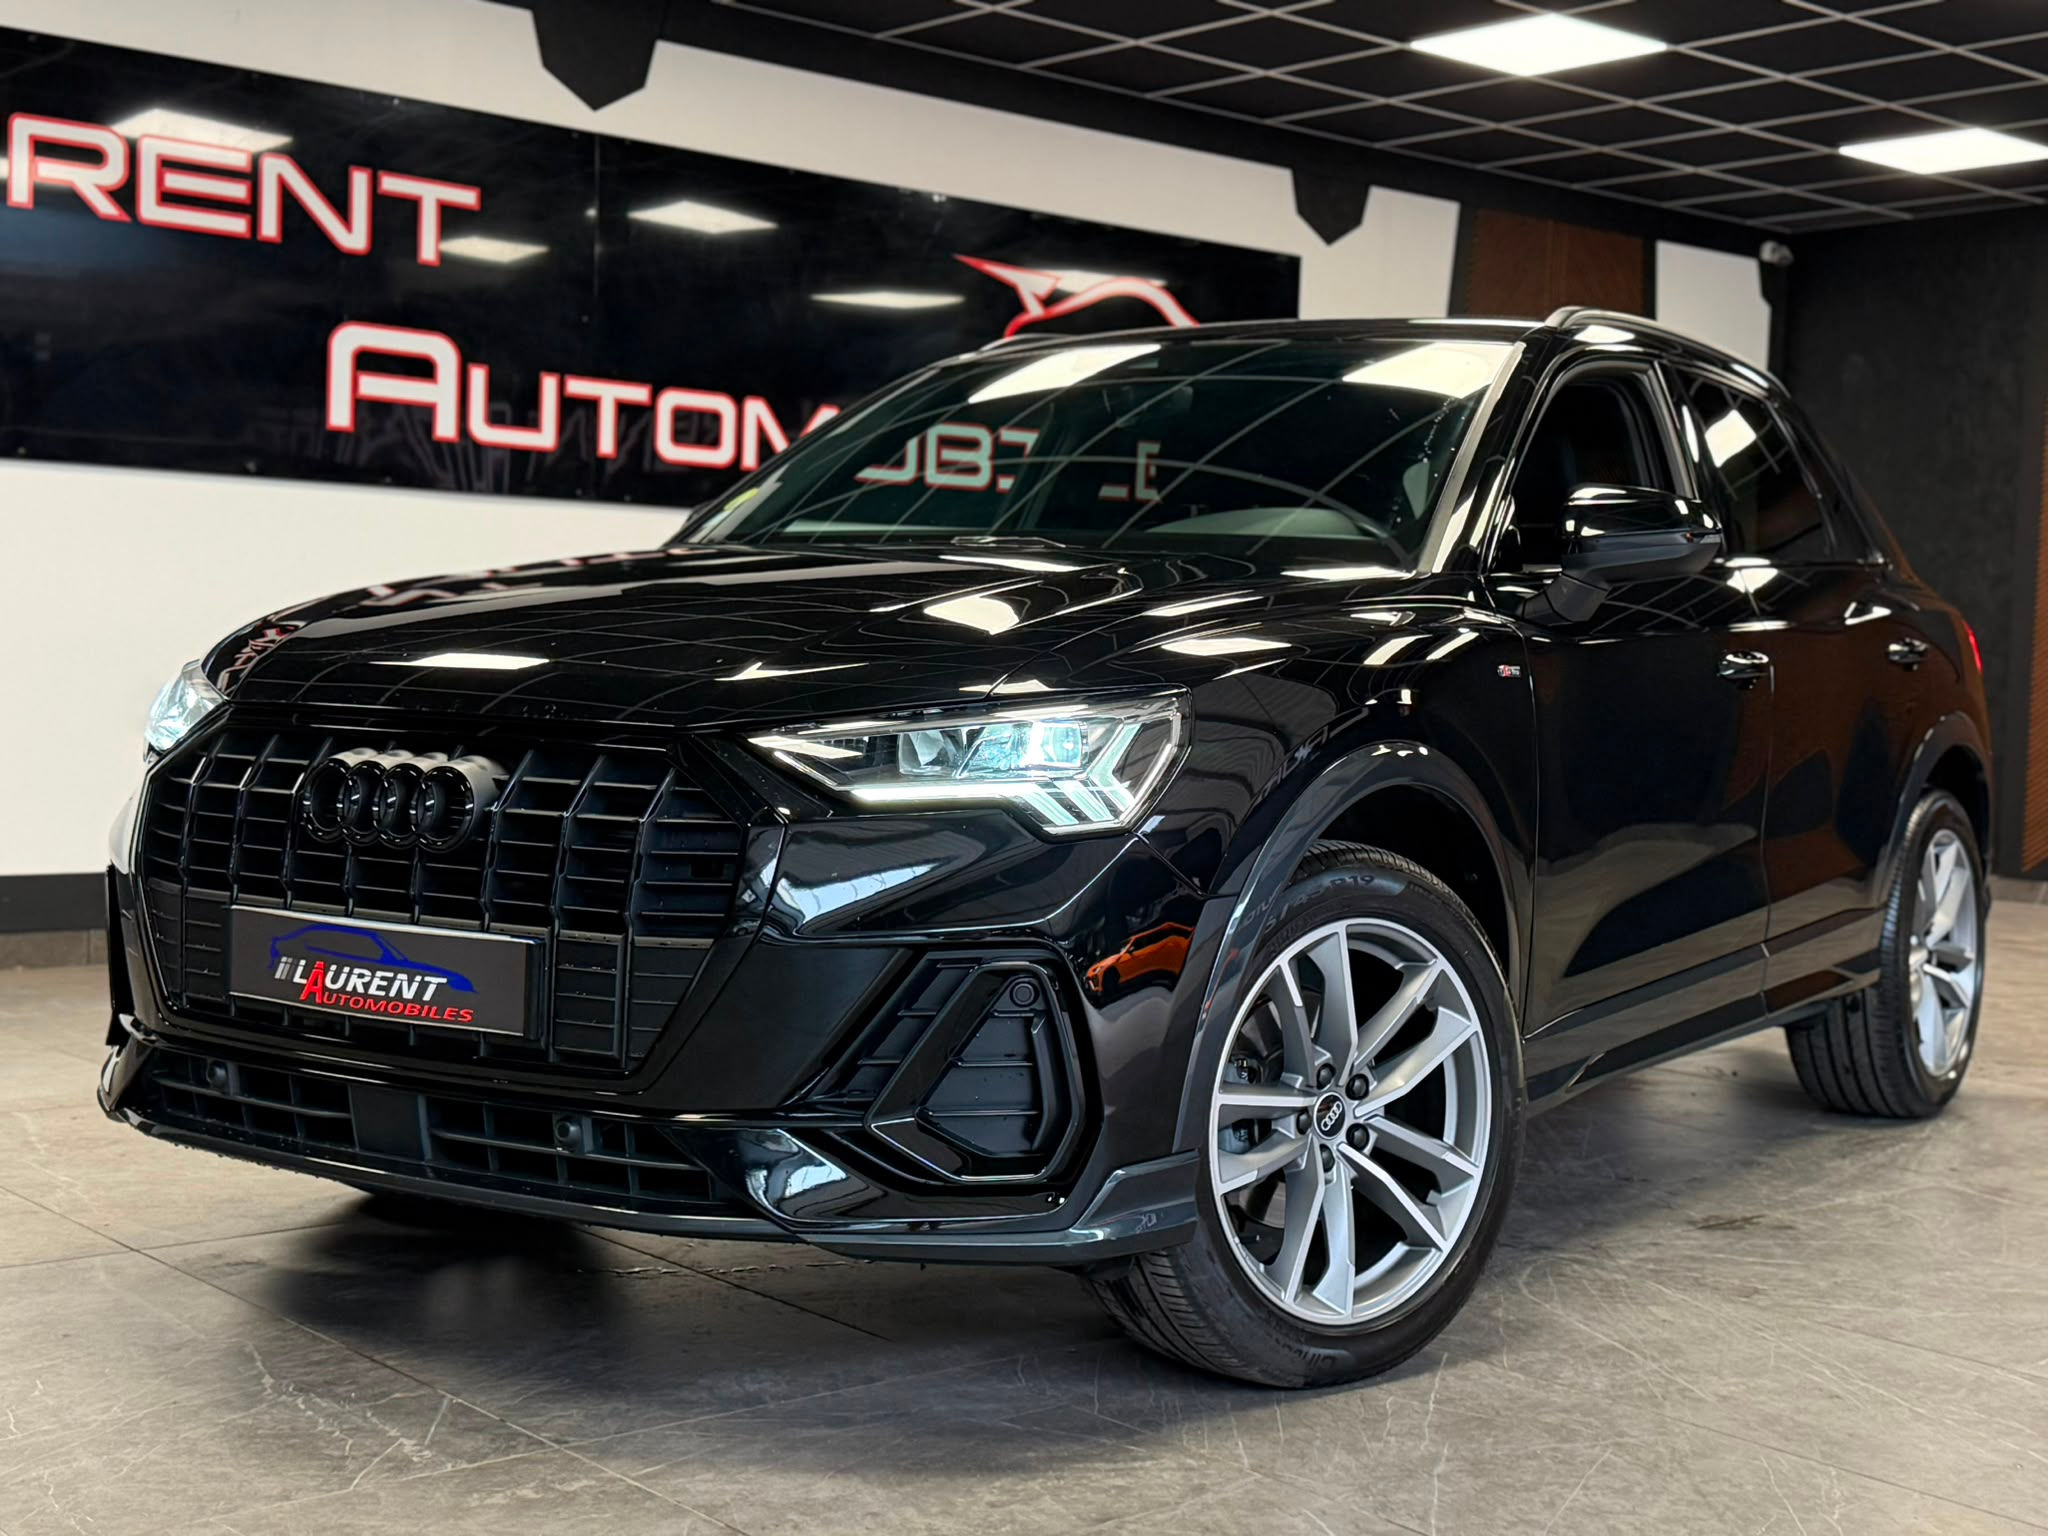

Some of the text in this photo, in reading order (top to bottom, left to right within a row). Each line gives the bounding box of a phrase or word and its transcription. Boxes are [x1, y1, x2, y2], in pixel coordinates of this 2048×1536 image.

[8, 112, 481, 266] RENT
[293, 959, 447, 1002] LAURENT
[301, 982, 474, 1022] AUTOMOBILES
